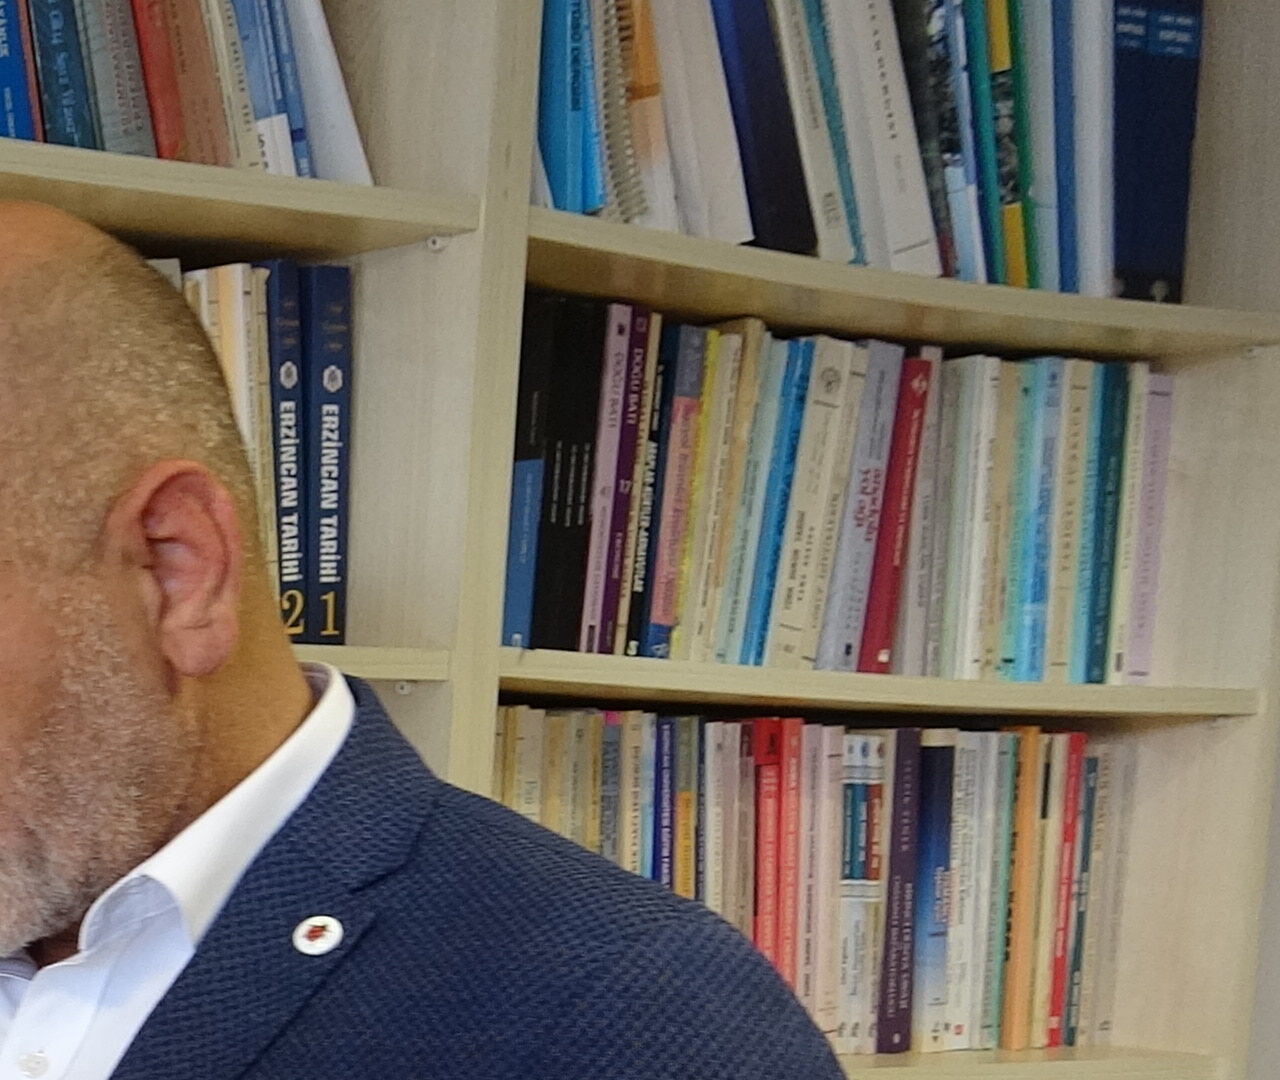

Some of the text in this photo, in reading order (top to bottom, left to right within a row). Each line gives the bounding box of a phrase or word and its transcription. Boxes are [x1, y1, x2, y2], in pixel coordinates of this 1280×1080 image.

[280, 399, 302, 507] ERZİNCAN
[320, 403, 343, 509] ERZİNCAN
[281, 512, 304, 582] TARİHİ
[319, 514, 342, 584] TARİHİ
